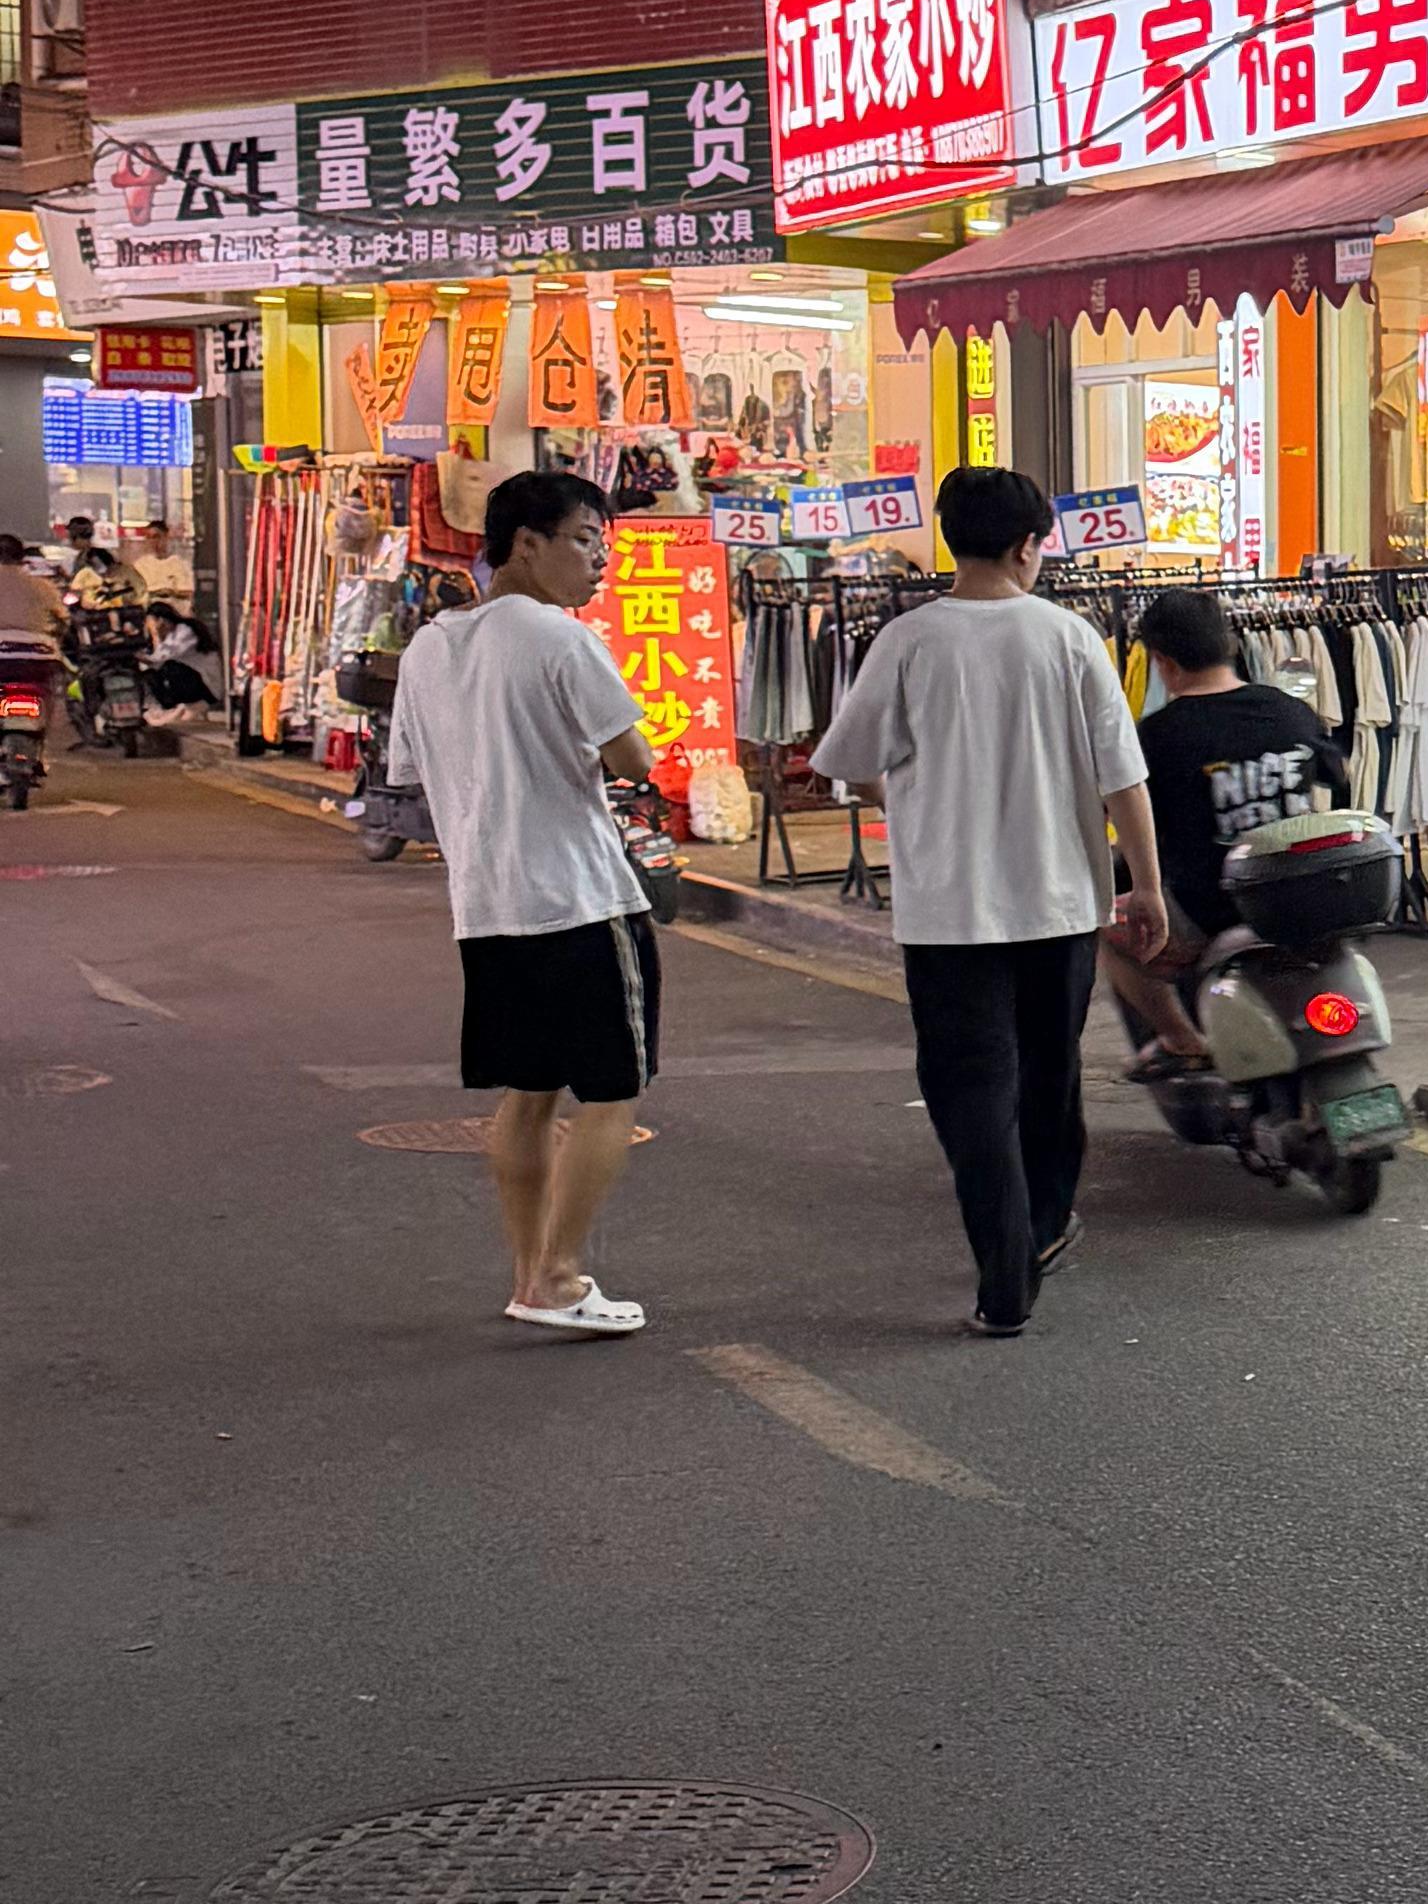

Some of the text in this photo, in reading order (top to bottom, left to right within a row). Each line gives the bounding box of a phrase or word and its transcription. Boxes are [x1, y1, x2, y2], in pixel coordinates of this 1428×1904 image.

[315, 80, 752, 212] 量繁多百货
[581, 217, 644, 251] 日用品
[654, 212, 699, 244] 箱包
[709, 208, 754, 240] 文具
[456, 326, 494, 406] 甩
[532, 313, 588, 414] 仓
[619, 309, 674, 423] 清
[613, 527, 693, 749] 江西小炒
